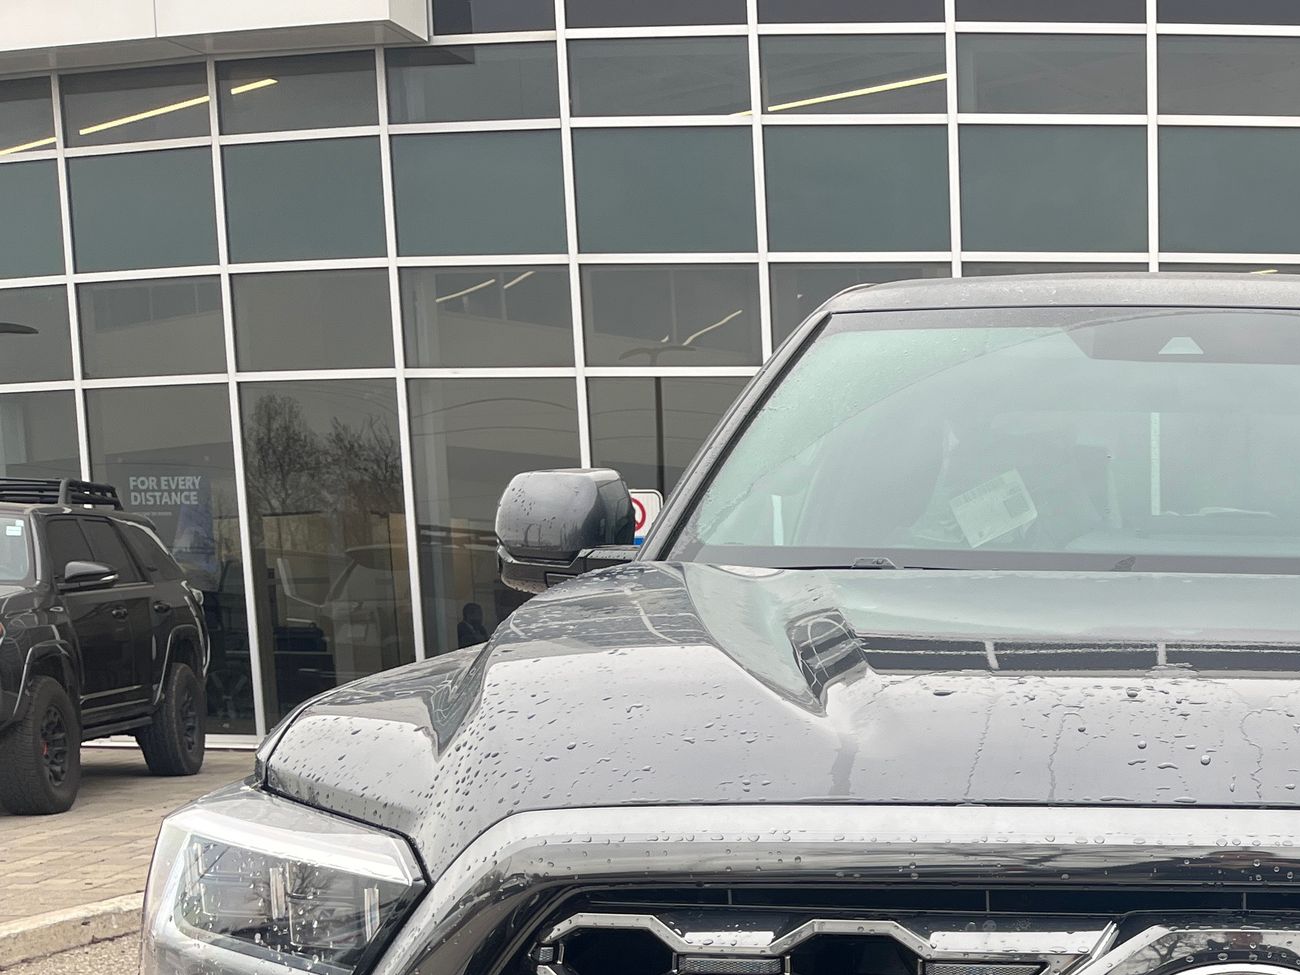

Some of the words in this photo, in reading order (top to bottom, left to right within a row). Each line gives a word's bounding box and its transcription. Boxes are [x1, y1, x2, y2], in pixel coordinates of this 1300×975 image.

[129, 476, 157, 490] FOR
[160, 475, 201, 490] EVERY
[130, 491, 198, 505] DISTANCE
